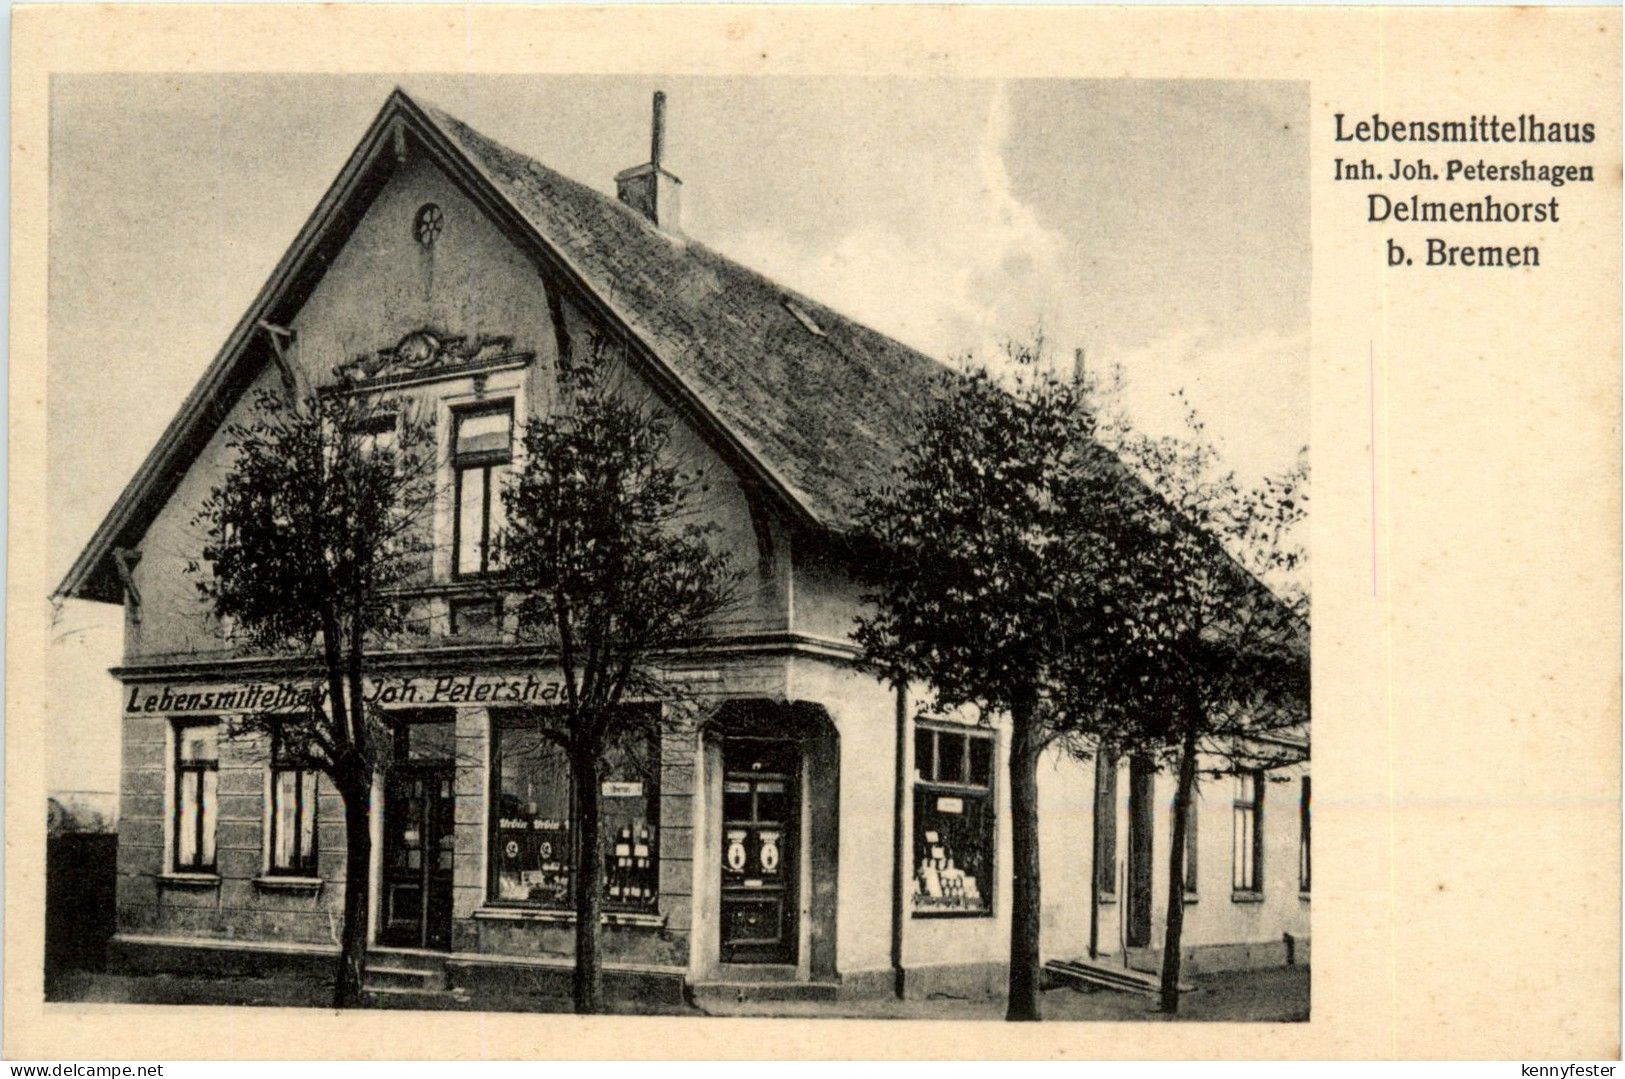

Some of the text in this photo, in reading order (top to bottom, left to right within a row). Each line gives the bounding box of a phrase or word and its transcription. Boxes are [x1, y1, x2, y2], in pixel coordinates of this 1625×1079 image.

[1334, 113, 1596, 143] Lebensmittelhaus
[1334, 158, 1594, 187] Inh. Joh. Petershagen
[1367, 194, 1560, 222] Delmenhorst
[1387, 239, 1541, 267] b. Bremen
